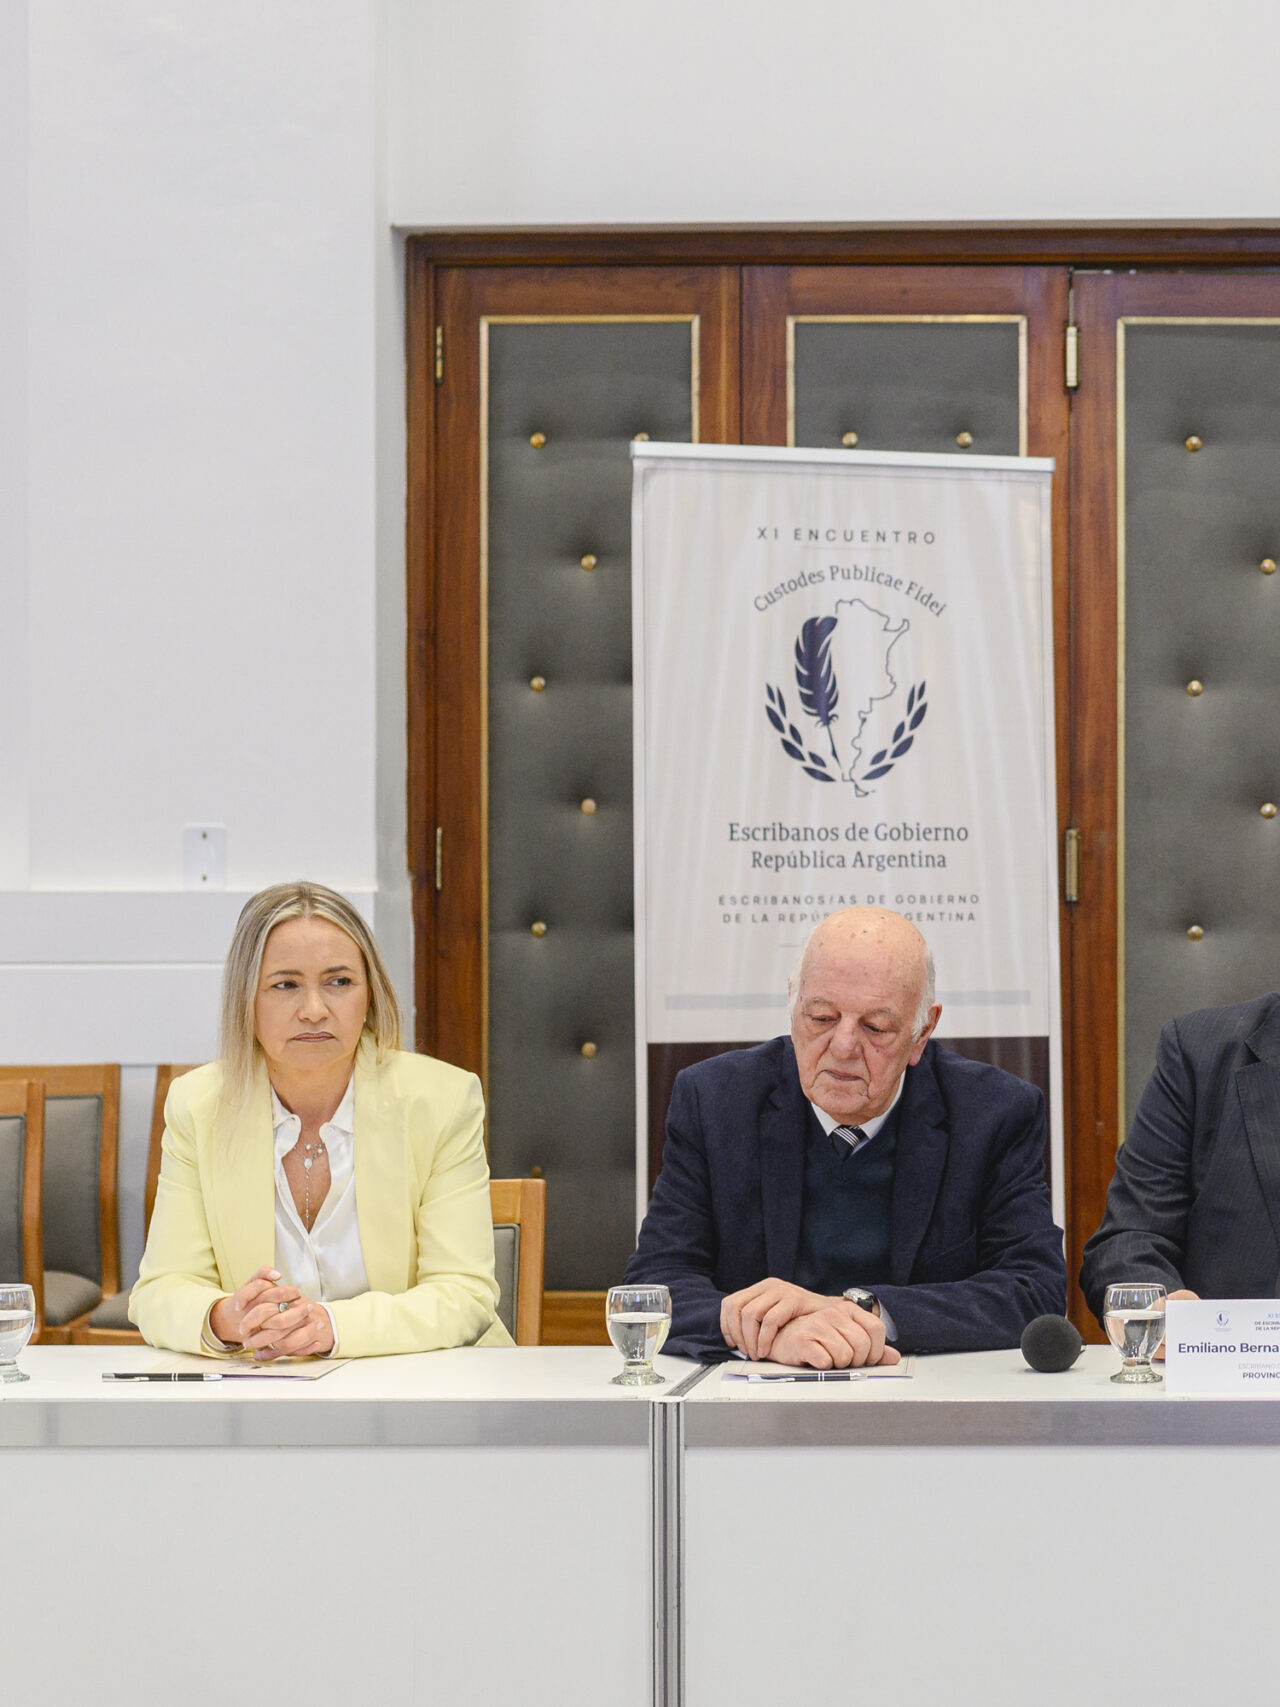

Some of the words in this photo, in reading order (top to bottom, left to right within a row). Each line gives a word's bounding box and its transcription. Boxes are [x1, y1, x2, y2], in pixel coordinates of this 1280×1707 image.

[758, 527, 778, 540] XI
[793, 528, 936, 545] ENCUENTRO
[753, 570, 826, 612] Custodes
[829, 564, 903, 590] Publicae
[905, 581, 947, 617] Fidei
[728, 822, 840, 842] Escribanos
[844, 822, 869, 842] de
[874, 822, 969, 842] Gobierno
[751, 850, 846, 872] República
[852, 850, 947, 872] Argentina
[717, 894, 858, 906] ESCRIBANOS/AS
[867, 894, 886, 905] DE
[895, 894, 980, 905] GOBIERNO
[722, 913, 742, 924] DE
[751, 913, 769, 924] LA
[903, 911, 976, 922] GENTINA
[1178, 1342, 1236, 1354] Emiliano
